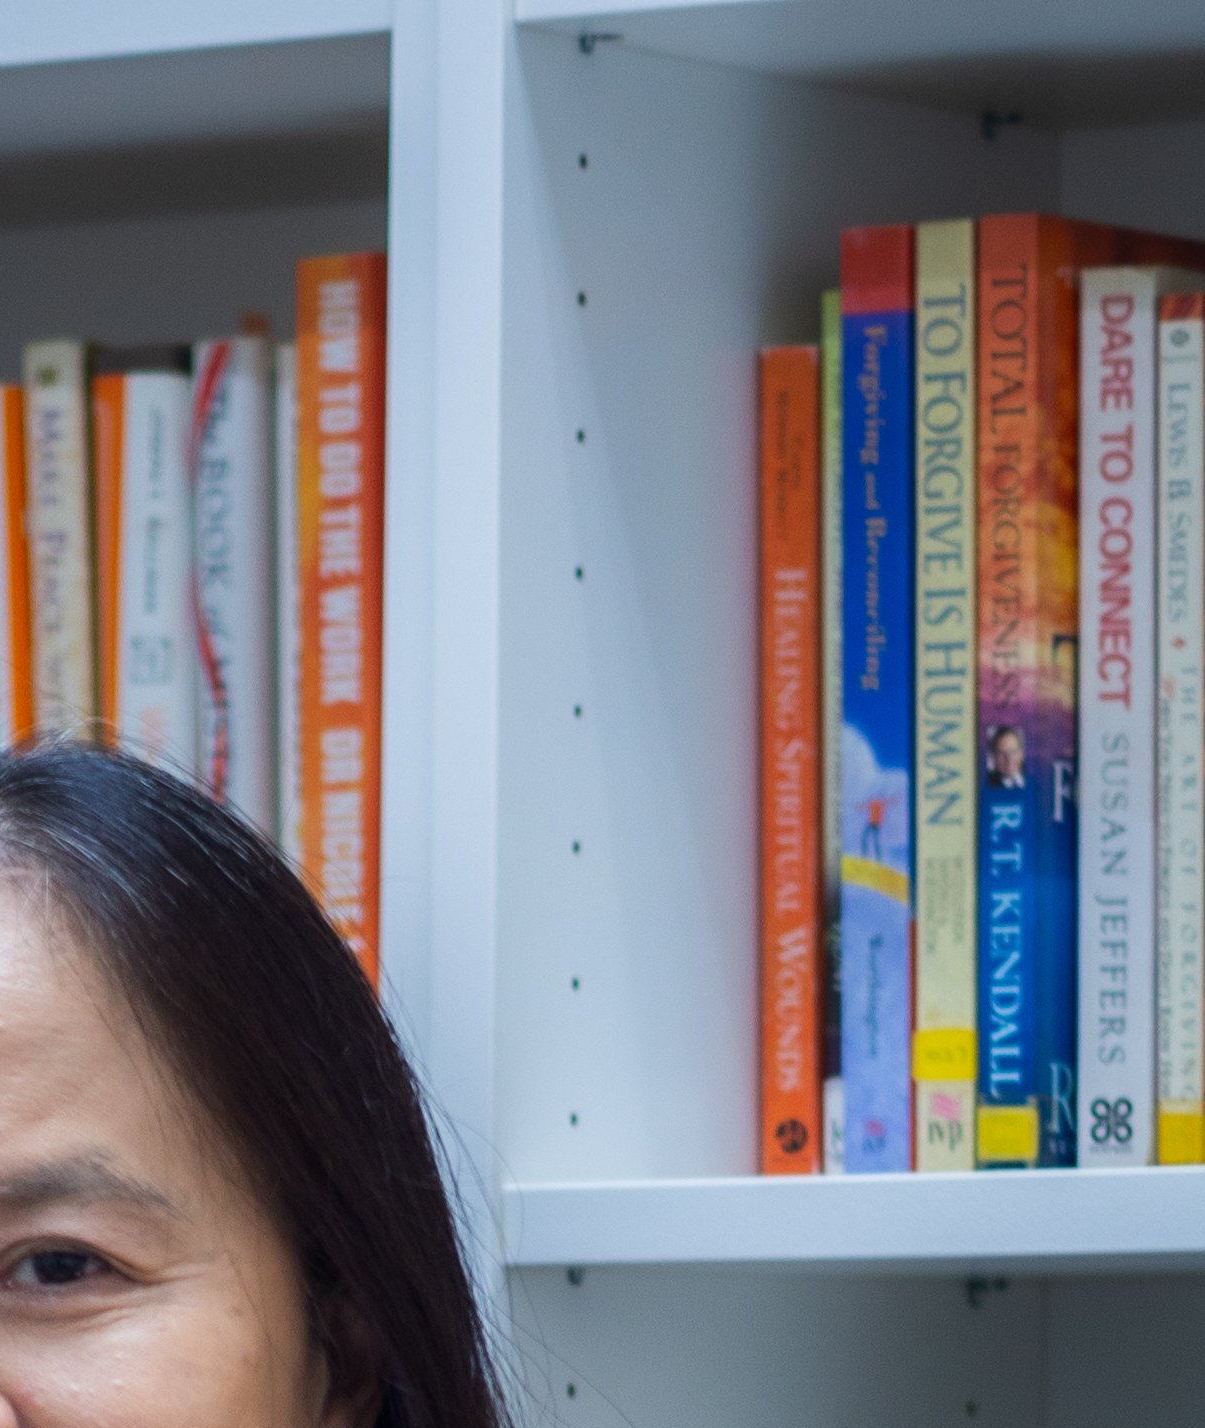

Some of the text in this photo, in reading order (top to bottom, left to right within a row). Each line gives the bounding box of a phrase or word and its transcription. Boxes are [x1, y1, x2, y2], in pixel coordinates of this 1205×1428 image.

[318, 279, 361, 373] HOW
[924, 284, 966, 357] TO
[318, 382, 361, 433] TO
[858, 325, 887, 464] Forgiving
[1168, 383, 1193, 468] LEWIS
[204, 454, 237, 585] BOOK
[318, 441, 361, 497] DO
[924, 371, 966, 573] FORGIVE
[991, 263, 1027, 711] TOTAL FORGIVENESS
[1097, 295, 1135, 710] DARE TO CONNECT
[318, 506, 361, 578] THE
[860, 518, 887, 692] Reconciling
[924, 588, 964, 626] IS
[1168, 511, 1193, 624] SMEDES
[318, 586, 362, 706] WORK
[773, 568, 808, 729] HEALING
[322, 727, 363, 783] DR
[925, 642, 965, 827] HUMAN
[774, 739, 808, 913] SPIRITUAL
[989, 804, 1023, 1098] R.T. KENDALL
[1095, 732, 1131, 1066] SUSAN JEFFERS
[777, 921, 809, 1092] WOUNDS
